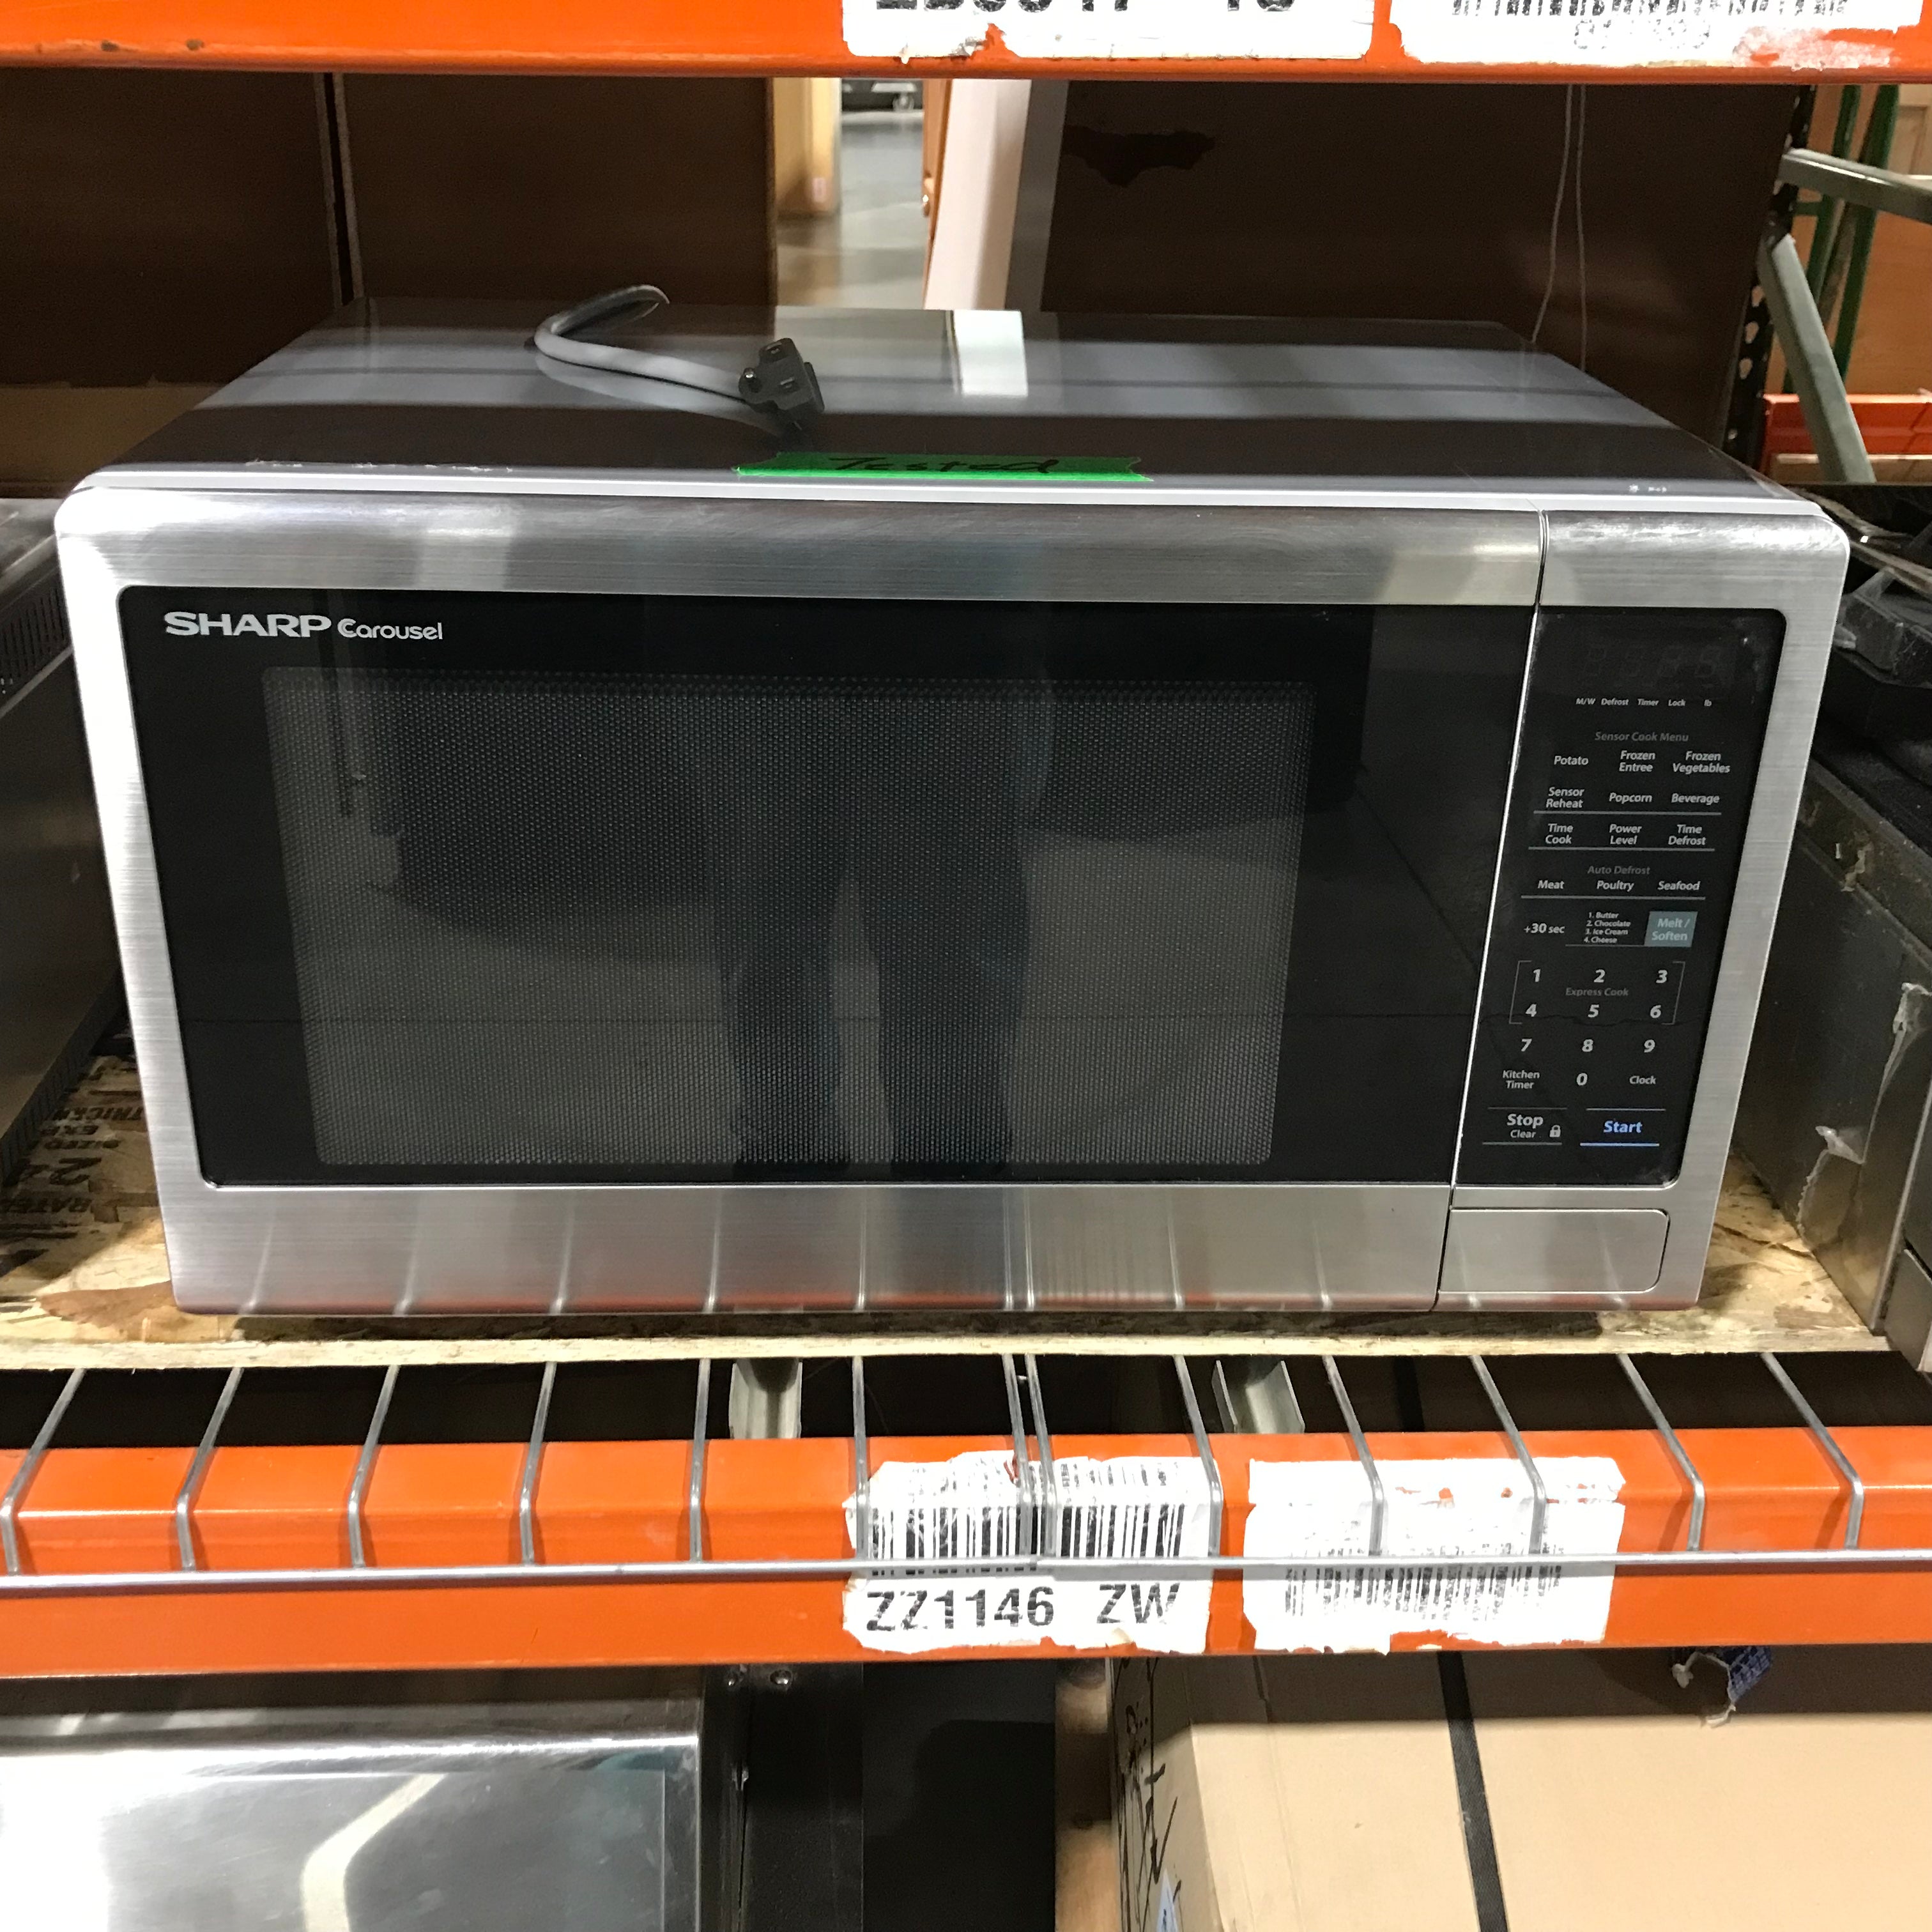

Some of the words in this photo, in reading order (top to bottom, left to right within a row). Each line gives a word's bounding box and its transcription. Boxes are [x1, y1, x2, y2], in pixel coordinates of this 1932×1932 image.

[829, 457, 1059, 473] Tested
[164, 611, 332, 638] SHARP
[337, 618, 443, 640] Carousel
[1601, 698, 1629, 706] Defrost
[1637, 698, 1659, 707] Timer
[1668, 699, 1686, 707] Lock
[1595, 732, 1630, 741] Sensor
[1632, 732, 1657, 741] Cook
[1659, 733, 1689, 742] Menu
[1554, 755, 1589, 765] Potato
[1620, 750, 1656, 760] Frozen
[1685, 751, 1721, 761] Frozen
[1618, 763, 1653, 772] Entree
[1673, 763, 1731, 774] Vegetables
[1548, 786, 1584, 797] Sensor
[1545, 799, 1583, 808] Reheat
[1609, 793, 1653, 804] Popcorn
[1671, 793, 1721, 805] Beverage
[1548, 823, 1574, 833] Time
[1609, 824, 1642, 833] Power
[1676, 824, 1703, 834] Time
[1545, 834, 1572, 845] Cook
[1609, 836, 1637, 845] Level
[1668, 836, 1706, 846] Defrost
[1587, 865, 1612, 875] Auto
[1614, 865, 1650, 875] Defrost
[1537, 880, 1565, 890] Meat
[1597, 880, 1635, 892] Poultry
[1657, 880, 1701, 891] Seafood
[1523, 923, 1547, 934] +30
[1548, 924, 1565, 934] sec
[1657, 918, 1683, 928] Melt
[1652, 931, 1688, 940] Soften
[1533, 969, 1542, 983] 1
[1593, 969, 1606, 983] 2
[1656, 970, 1668, 984] 3
[1565, 987, 1602, 997] Express
[1604, 987, 1629, 997] Cook
[1525, 1004, 1537, 1017] 4
[1588, 1004, 1600, 1018] 5
[1650, 1005, 1662, 1018] 6
[1521, 1038, 1533, 1052] 7
[1581, 1039, 1594, 1052] 8
[1644, 1039, 1656, 1053] 9
[1503, 1070, 1540, 1080] Kitchen
[1576, 1073, 1588, 1086] 0
[1629, 1075, 1657, 1085] Clock
[1506, 1080, 1535, 1089] Timer
[1506, 1113, 1544, 1128] Stop
[1603, 1120, 1643, 1134] Start
[1510, 1129, 1537, 1139] Clear
[866, 1586, 1055, 1632] ZZ1146
[1096, 1582, 1181, 1625] ZW
